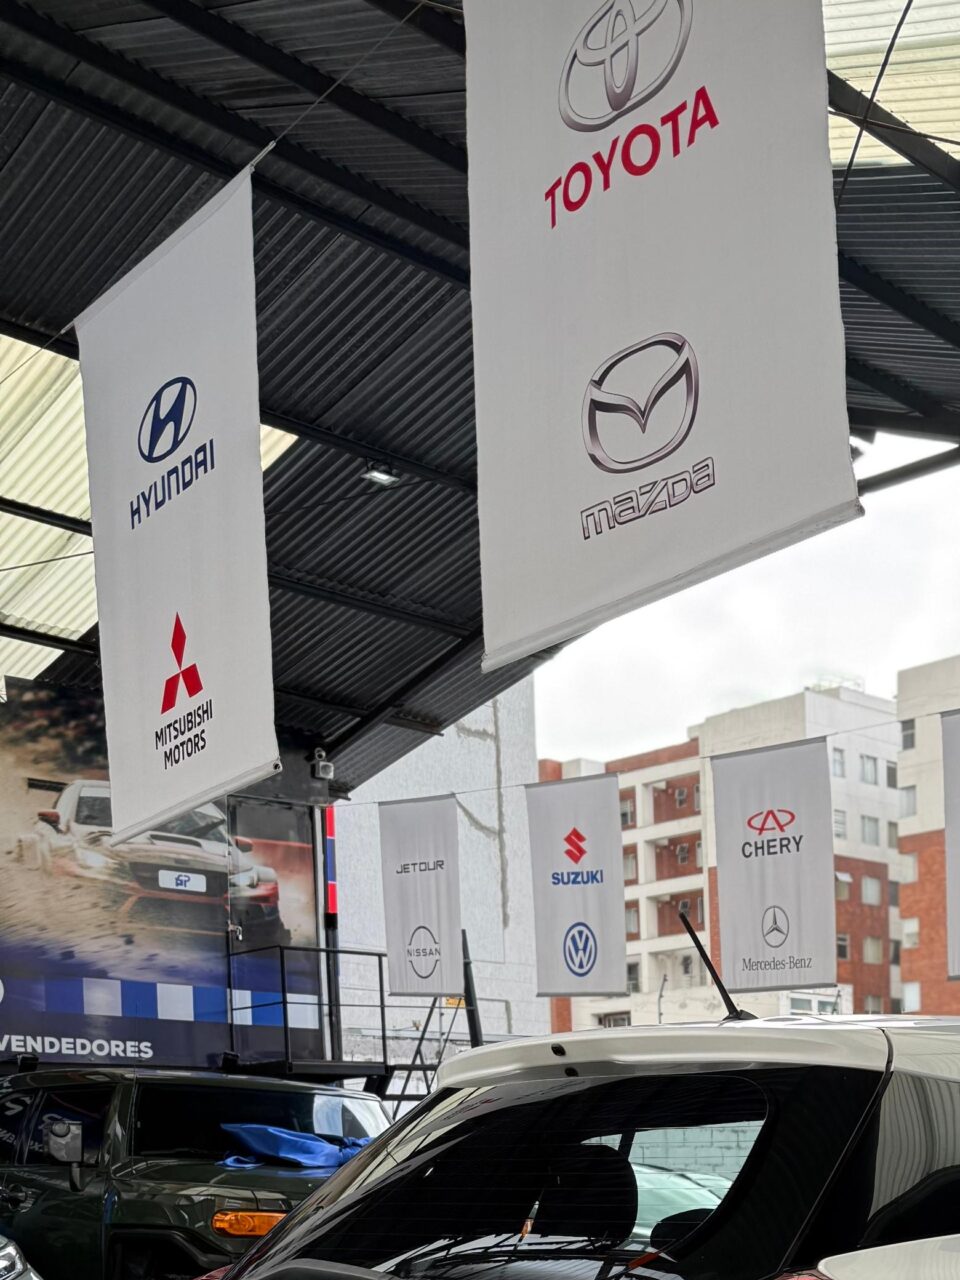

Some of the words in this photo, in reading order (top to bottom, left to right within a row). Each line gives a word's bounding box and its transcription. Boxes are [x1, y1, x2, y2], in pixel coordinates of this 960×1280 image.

[544, 85, 720, 230] TOYOTA
[130, 438, 216, 530] HYUNDAI
[154, 699, 214, 751] MITSUBISHI
[163, 730, 207, 770] MOTORS
[741, 834, 803, 859] CHERY
[396, 859, 445, 875] JETOUR
[551, 869, 604, 886] SUZUKI
[406, 948, 441, 958] NISSAN
[742, 955, 813, 972] Mercedes-Benz
[0, 1034, 154, 1059] VENDEDORES
